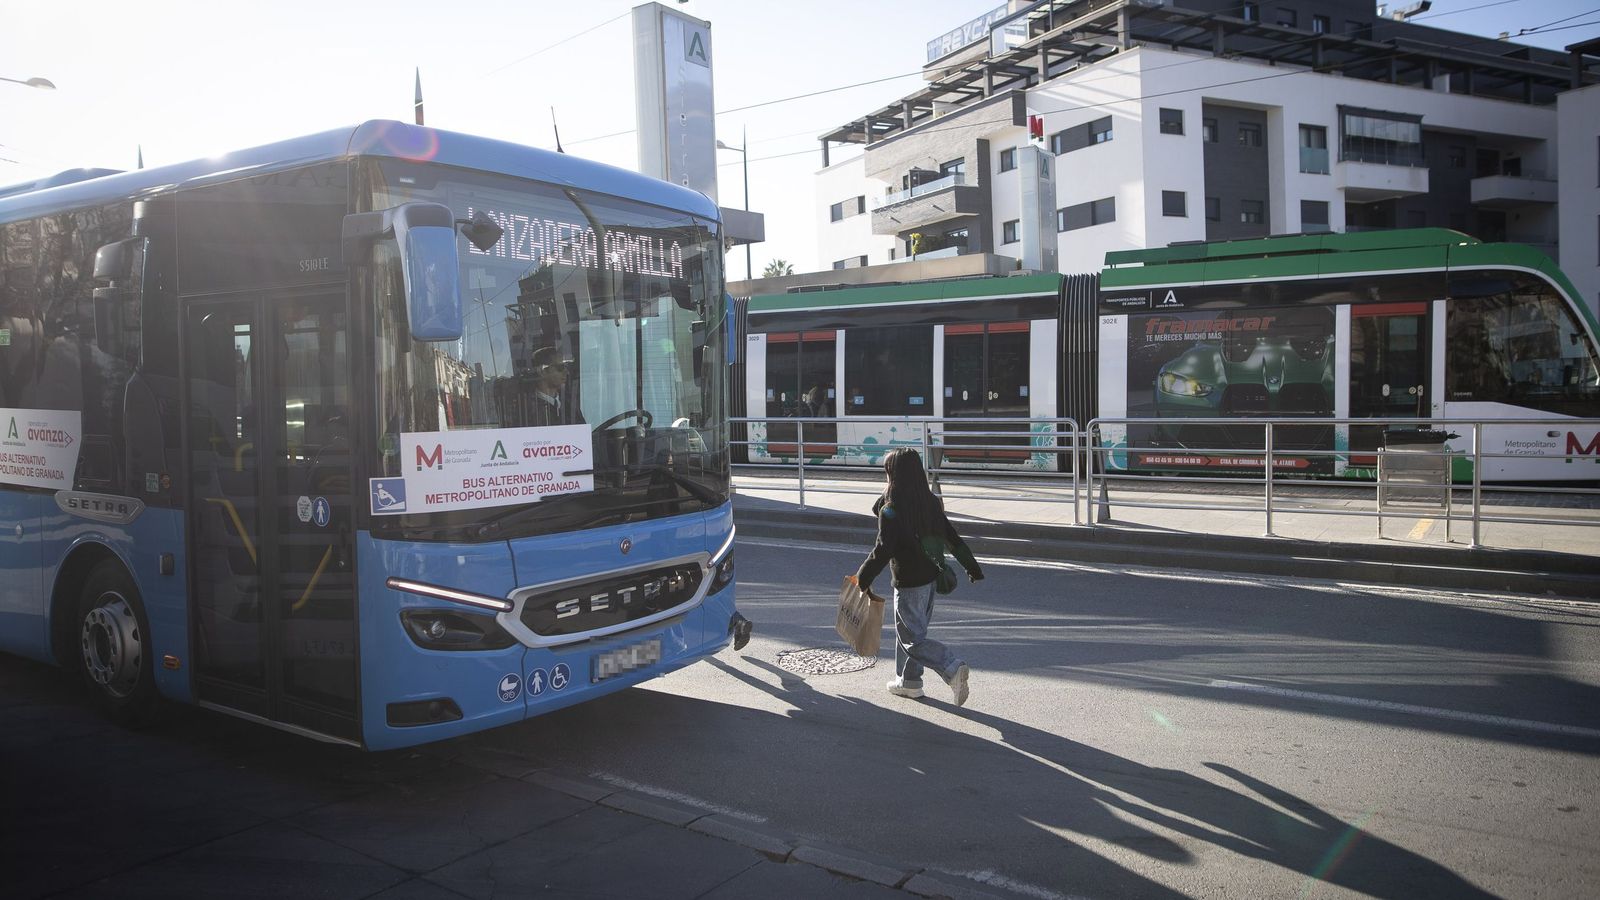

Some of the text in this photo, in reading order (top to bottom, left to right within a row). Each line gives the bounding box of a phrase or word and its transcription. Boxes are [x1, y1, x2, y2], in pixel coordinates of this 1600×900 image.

[603, 229, 683, 279] ARMILLA
[1145, 316, 1276, 335] framacar
[1146, 331, 1222, 342] TE MERECES MUCHO MÁS
[27, 428, 64, 443] avanza
[522, 444, 571, 459] avanza
[1504, 440, 1557, 448] Metropolitano
[8, 453, 46, 466] ALTERNATIVO
[444, 448, 478, 457] Metropolitano
[452, 456, 472, 464] Granada
[26, 467, 34, 477] DE
[35, 468, 65, 480] GRANADA
[462, 472, 553, 489] BUS ALTERNATIVO
[425, 481, 580, 504] METROPOLITANO DE GRANADA
[68, 498, 128, 514] SETRA
[555, 576, 685, 619] SETRA
